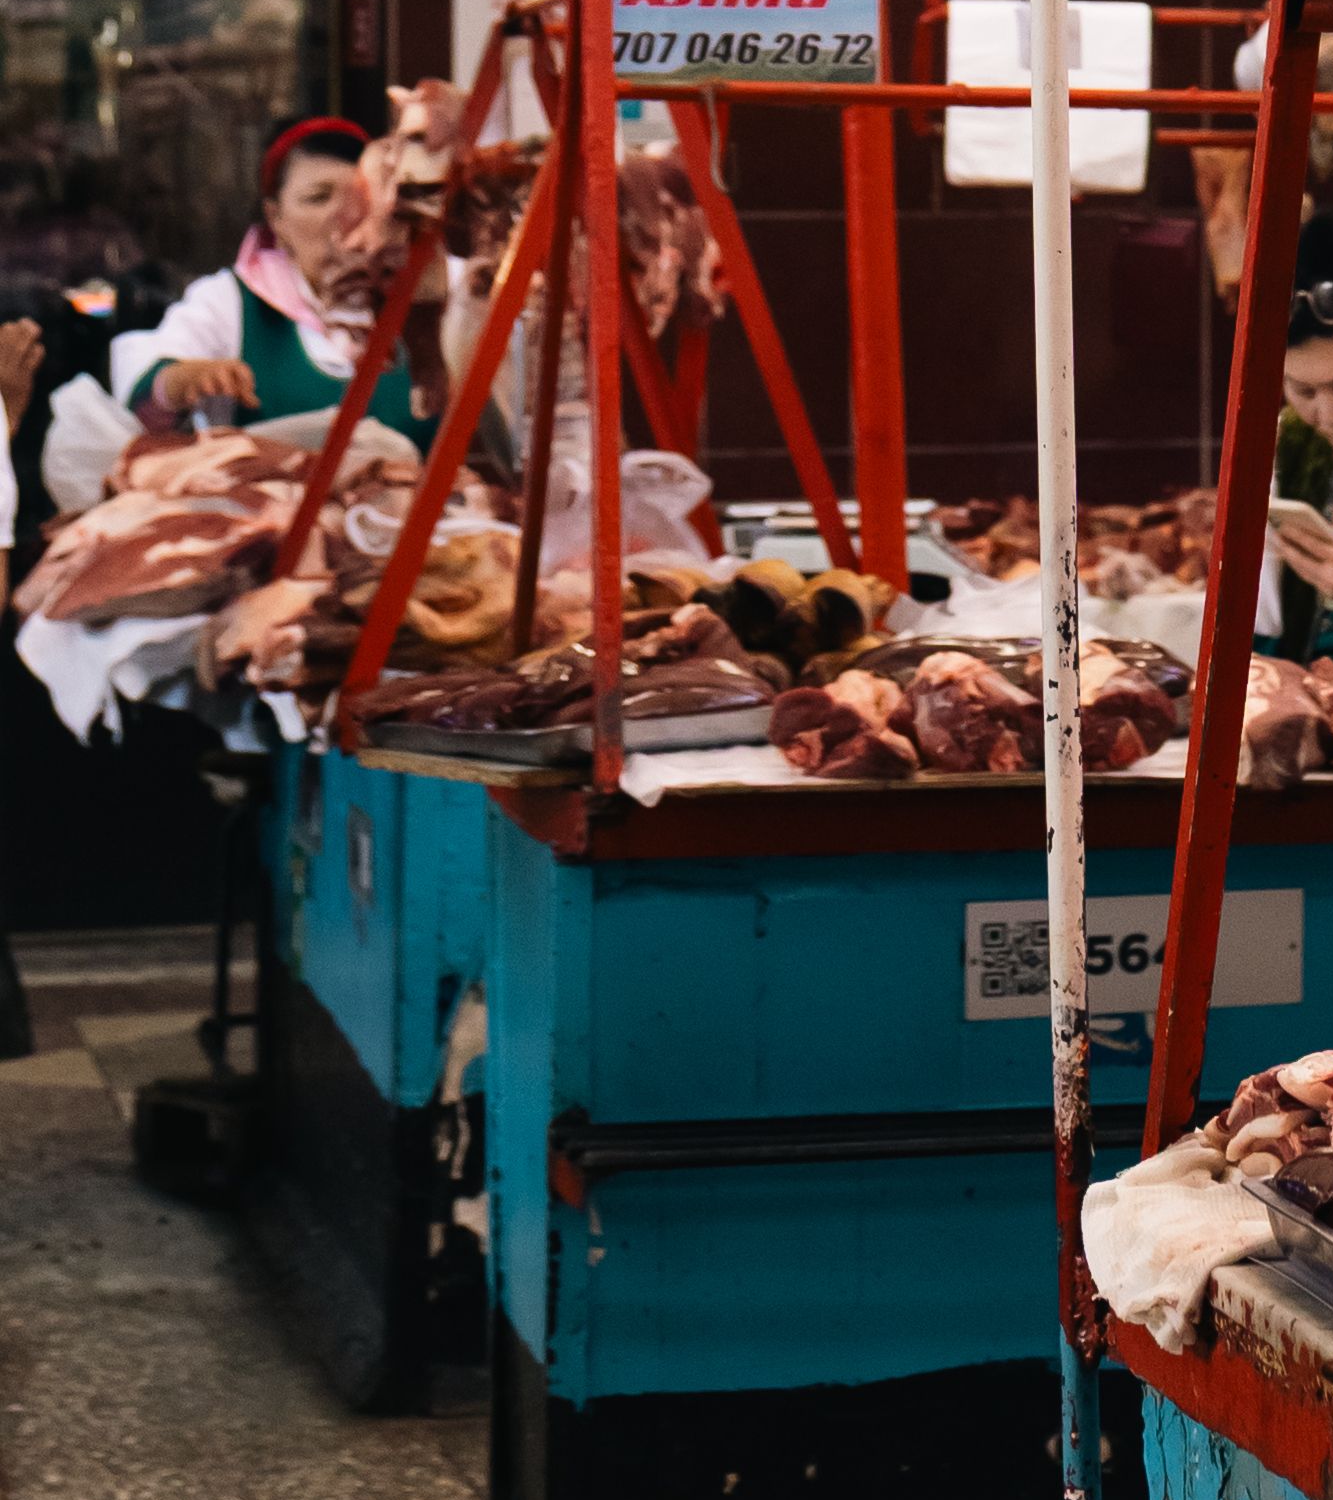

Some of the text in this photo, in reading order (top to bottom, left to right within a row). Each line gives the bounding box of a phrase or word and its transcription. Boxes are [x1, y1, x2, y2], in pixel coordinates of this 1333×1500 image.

[614, 31, 874, 66] 707 046 26 72
